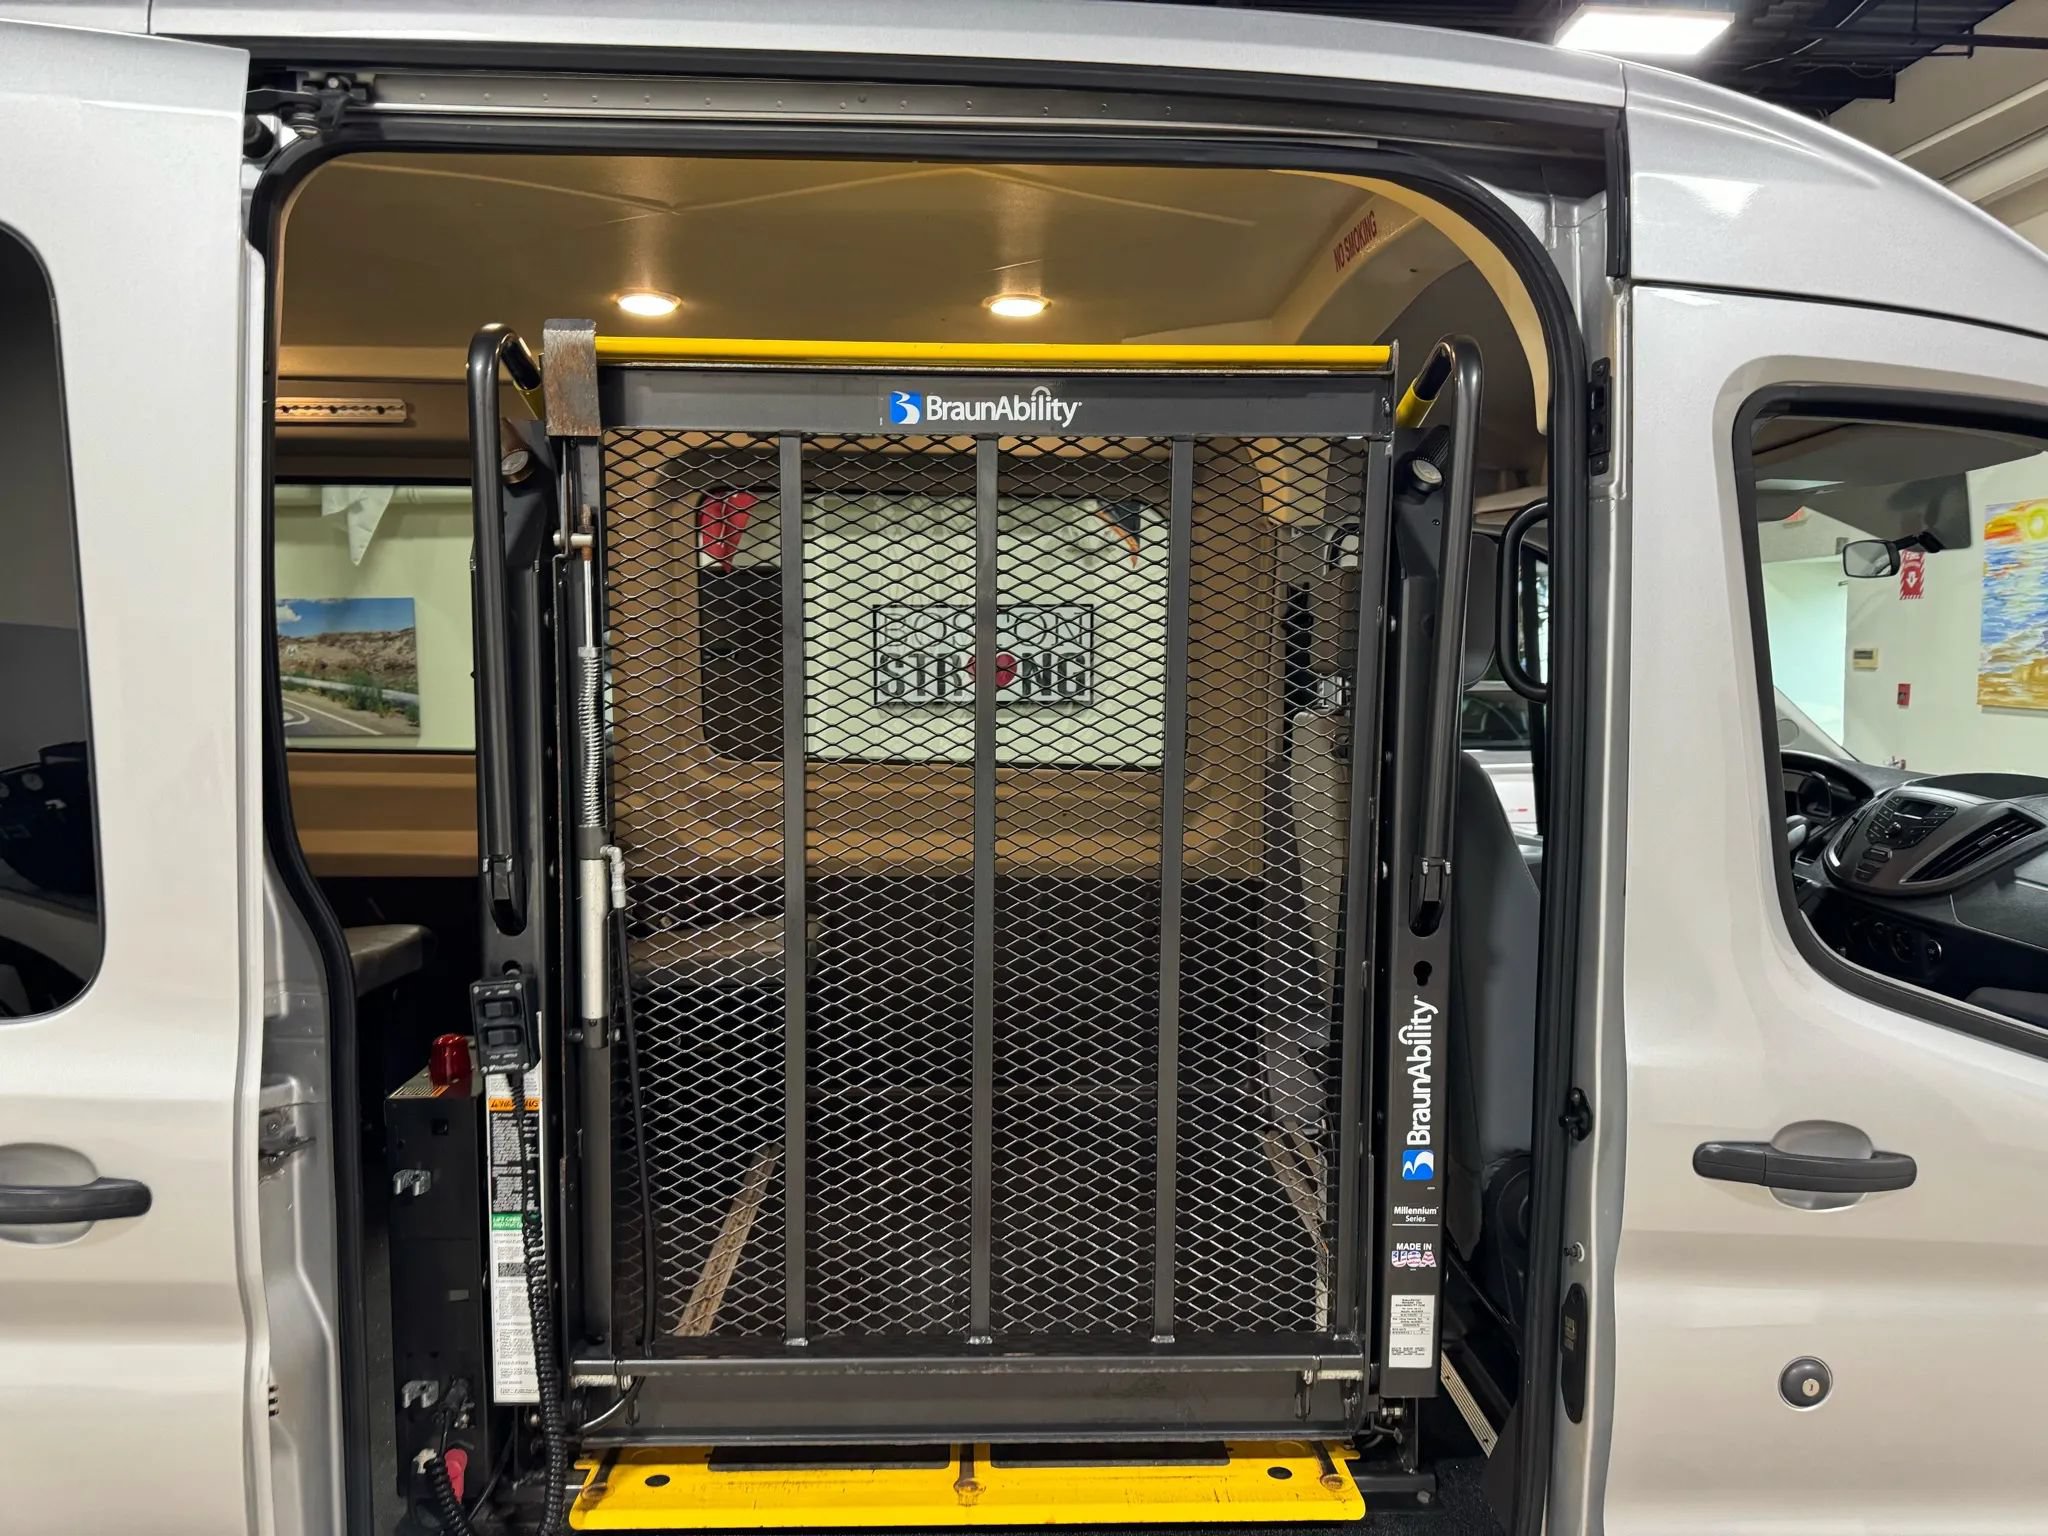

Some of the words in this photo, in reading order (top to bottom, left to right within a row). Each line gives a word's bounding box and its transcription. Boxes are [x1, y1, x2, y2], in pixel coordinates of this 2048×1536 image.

[1333, 244, 1345, 272] NO
[1344, 210, 1377, 262] SMOKING
[926, 386, 1078, 428] BraunAbility
[1398, 998, 1439, 1146] BraunAbility
[1393, 1206, 1438, 1215] Millennium
[1405, 1215, 1426, 1223] Series
[1391, 1250, 1437, 1268] USA
